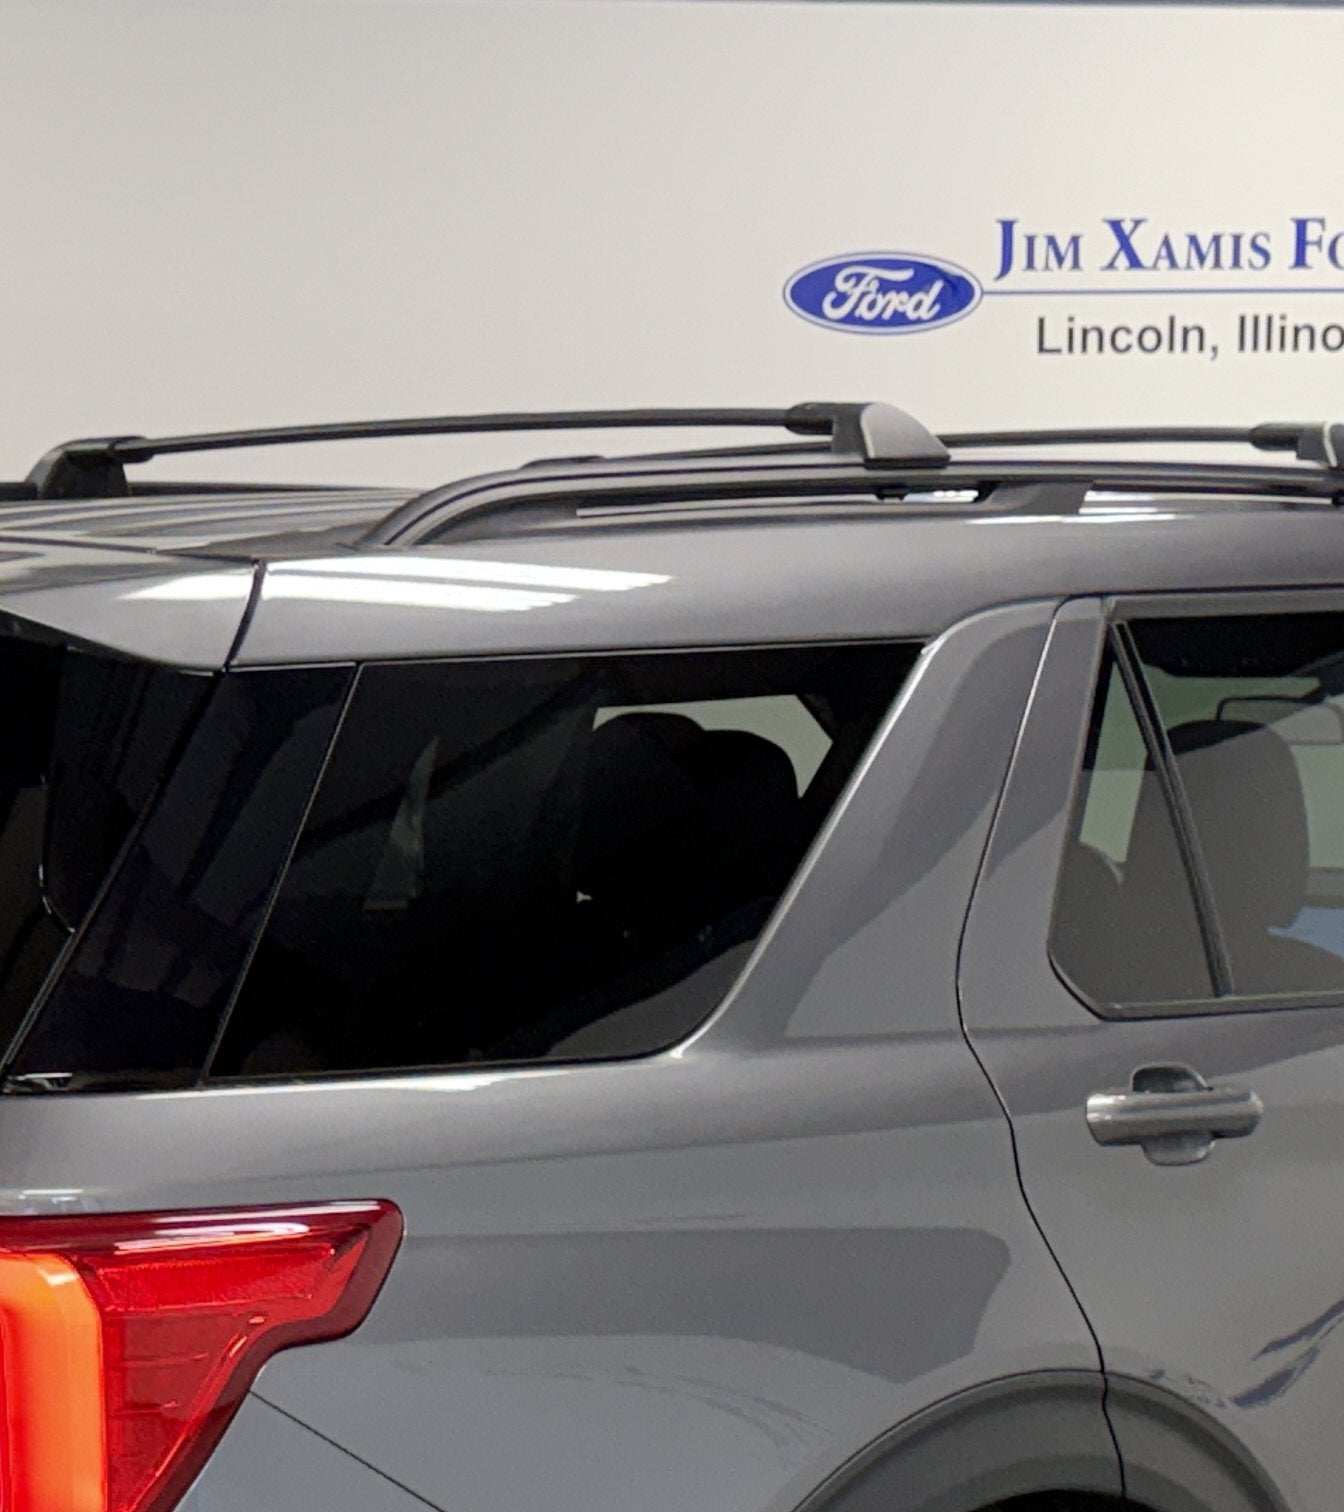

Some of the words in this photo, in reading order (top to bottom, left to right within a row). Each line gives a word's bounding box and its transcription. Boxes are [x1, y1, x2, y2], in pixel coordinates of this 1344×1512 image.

[994, 218, 1084, 282] JIM
[1101, 218, 1273, 273] XAMIS
[821, 264, 944, 321] Ford
[1037, 316, 1220, 362] Lincoln,
